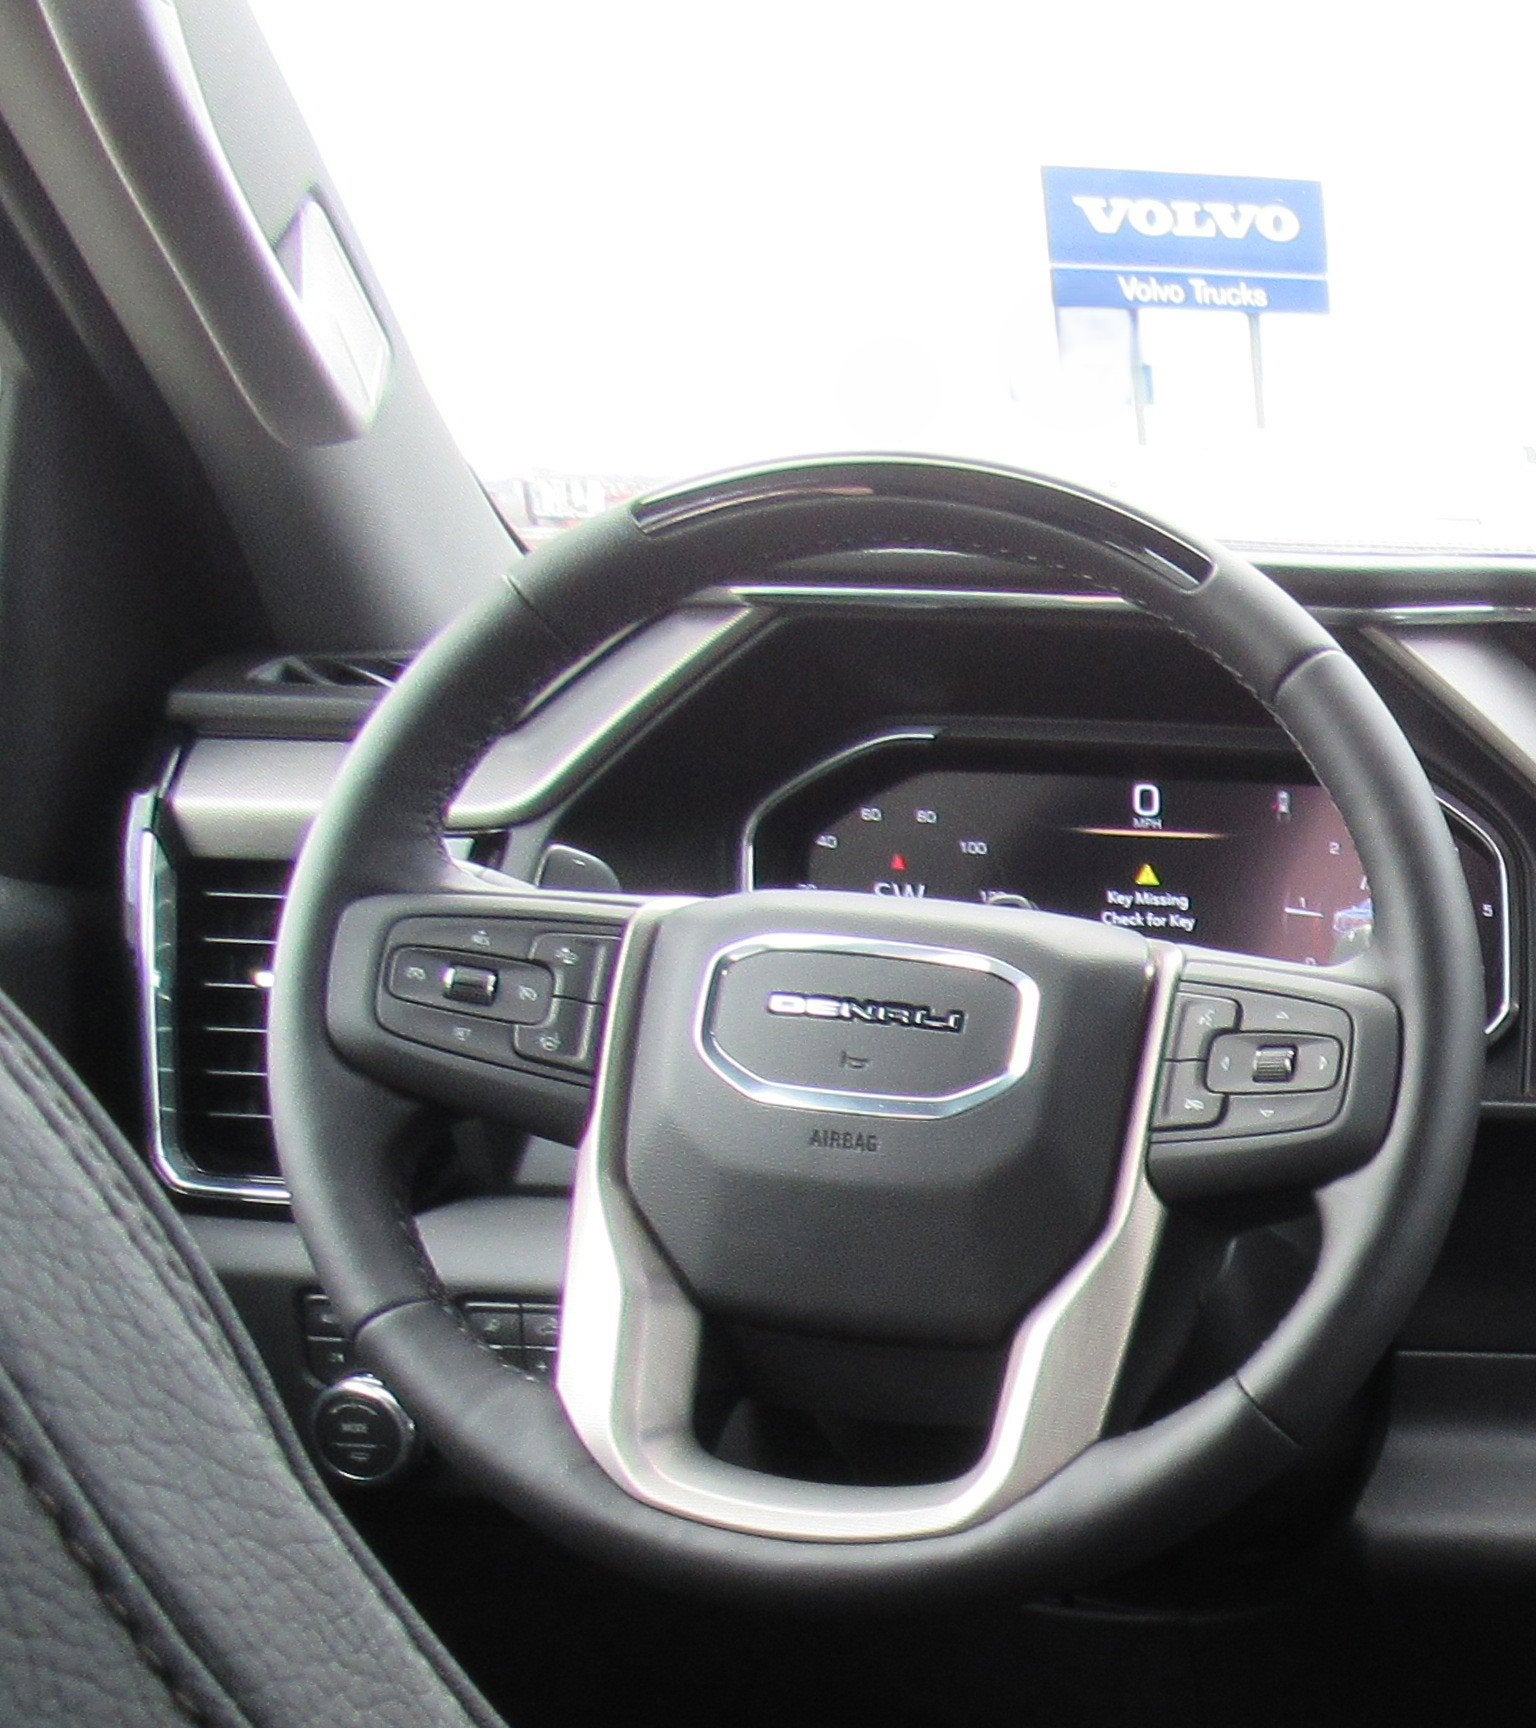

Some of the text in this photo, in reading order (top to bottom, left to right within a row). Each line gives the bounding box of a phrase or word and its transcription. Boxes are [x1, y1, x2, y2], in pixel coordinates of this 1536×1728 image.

[1071, 195, 1301, 242] VOLVO
[1117, 275, 1268, 308] Volvo Trucks
[1132, 783, 1161, 817] 0
[860, 807, 882, 822] 60
[1132, 818, 1162, 829] MPH
[816, 834, 838, 849] 40
[959, 840, 988, 855] 100
[1329, 841, 1340, 855] 2
[1106, 890, 1189, 911] Key Missing
[1482, 903, 1494, 917] 5
[1102, 910, 1196, 933] Check for Key
[767, 993, 966, 1034] DENALI
[808, 1129, 879, 1153] AIRBAG
